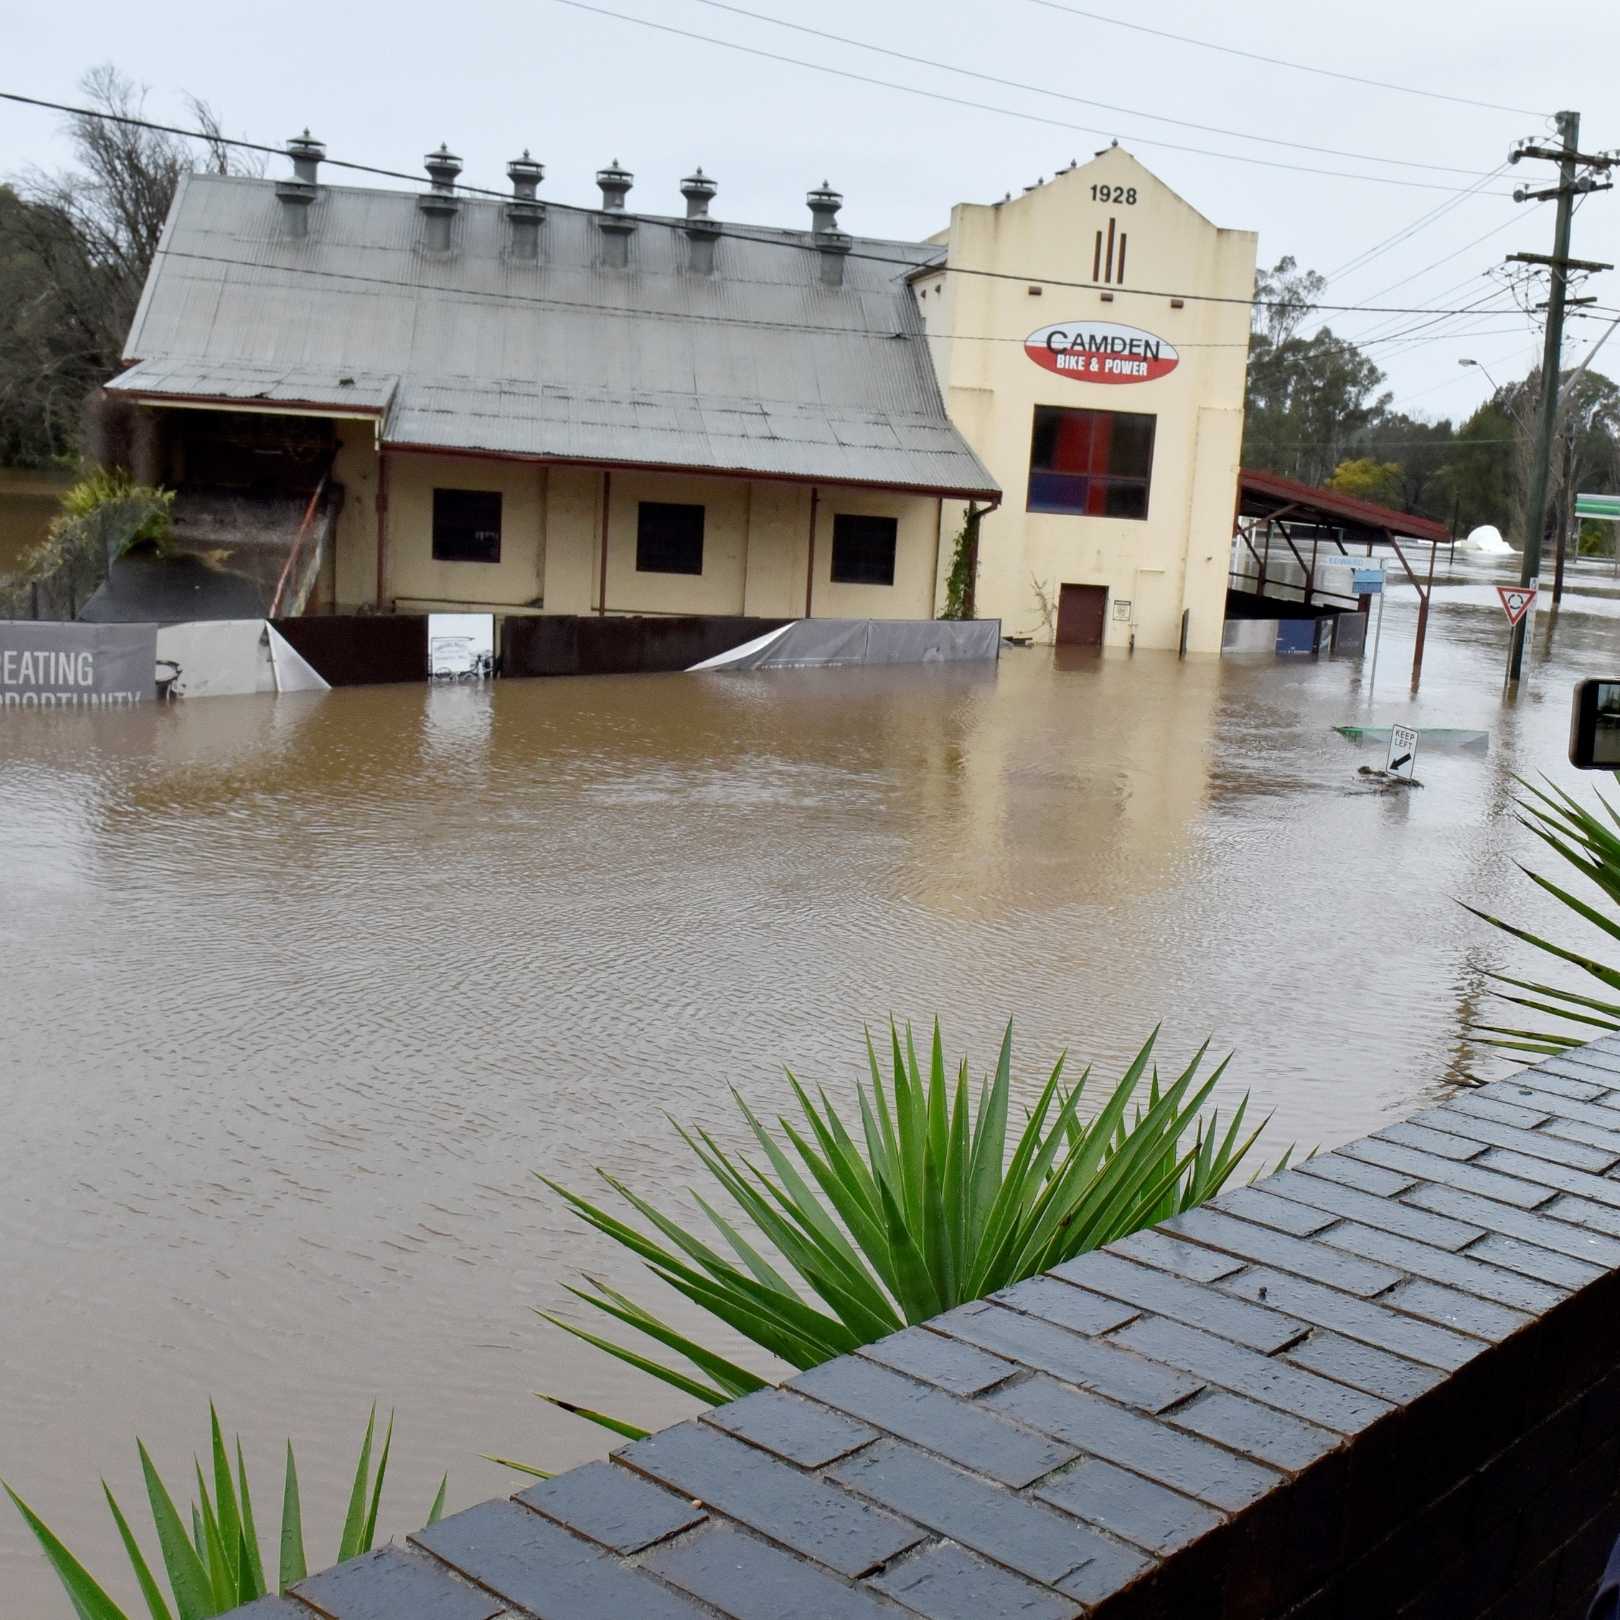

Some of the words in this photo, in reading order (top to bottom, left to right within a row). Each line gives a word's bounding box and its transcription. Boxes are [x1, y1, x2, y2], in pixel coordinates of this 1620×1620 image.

[1090, 184, 1137, 205] 1928
[1046, 330, 1161, 362] CAMDEN
[1056, 354, 1085, 370] BIKE
[1089, 357, 1099, 372] &
[1104, 359, 1148, 376] POWER
[0, 651, 94, 685] EATING
[1394, 739, 1413, 750] LEFT
[1395, 730, 1415, 740] KEEP
